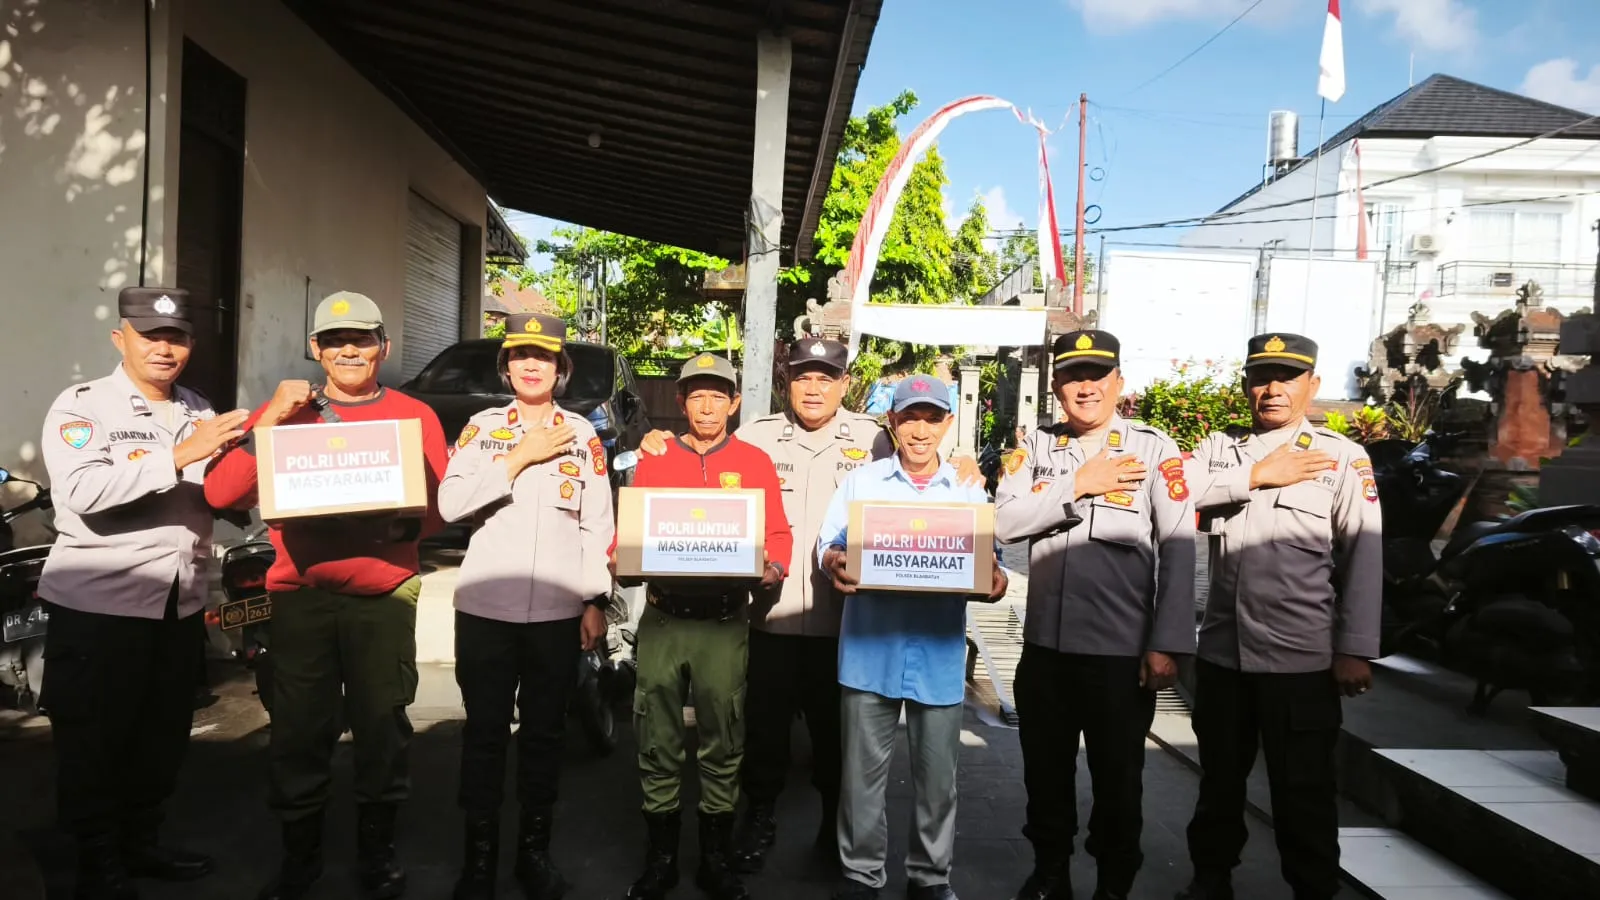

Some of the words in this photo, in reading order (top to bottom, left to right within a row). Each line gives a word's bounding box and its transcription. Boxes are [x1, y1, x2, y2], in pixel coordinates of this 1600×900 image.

[109, 431, 156, 442] SUARTIKA
[480, 439, 505, 451] PUTU
[285, 454, 333, 471] POLRI
[337, 449, 391, 467] UNTUK
[287, 470, 392, 491] MASYARAKAT
[658, 521, 694, 536] POLRI
[697, 521, 741, 537] UNTUK
[658, 540, 739, 553] MASYARAKAT
[873, 533, 914, 549] POLRI
[917, 535, 966, 551] UNTUK
[873, 553, 966, 571] MASYARAKAT
